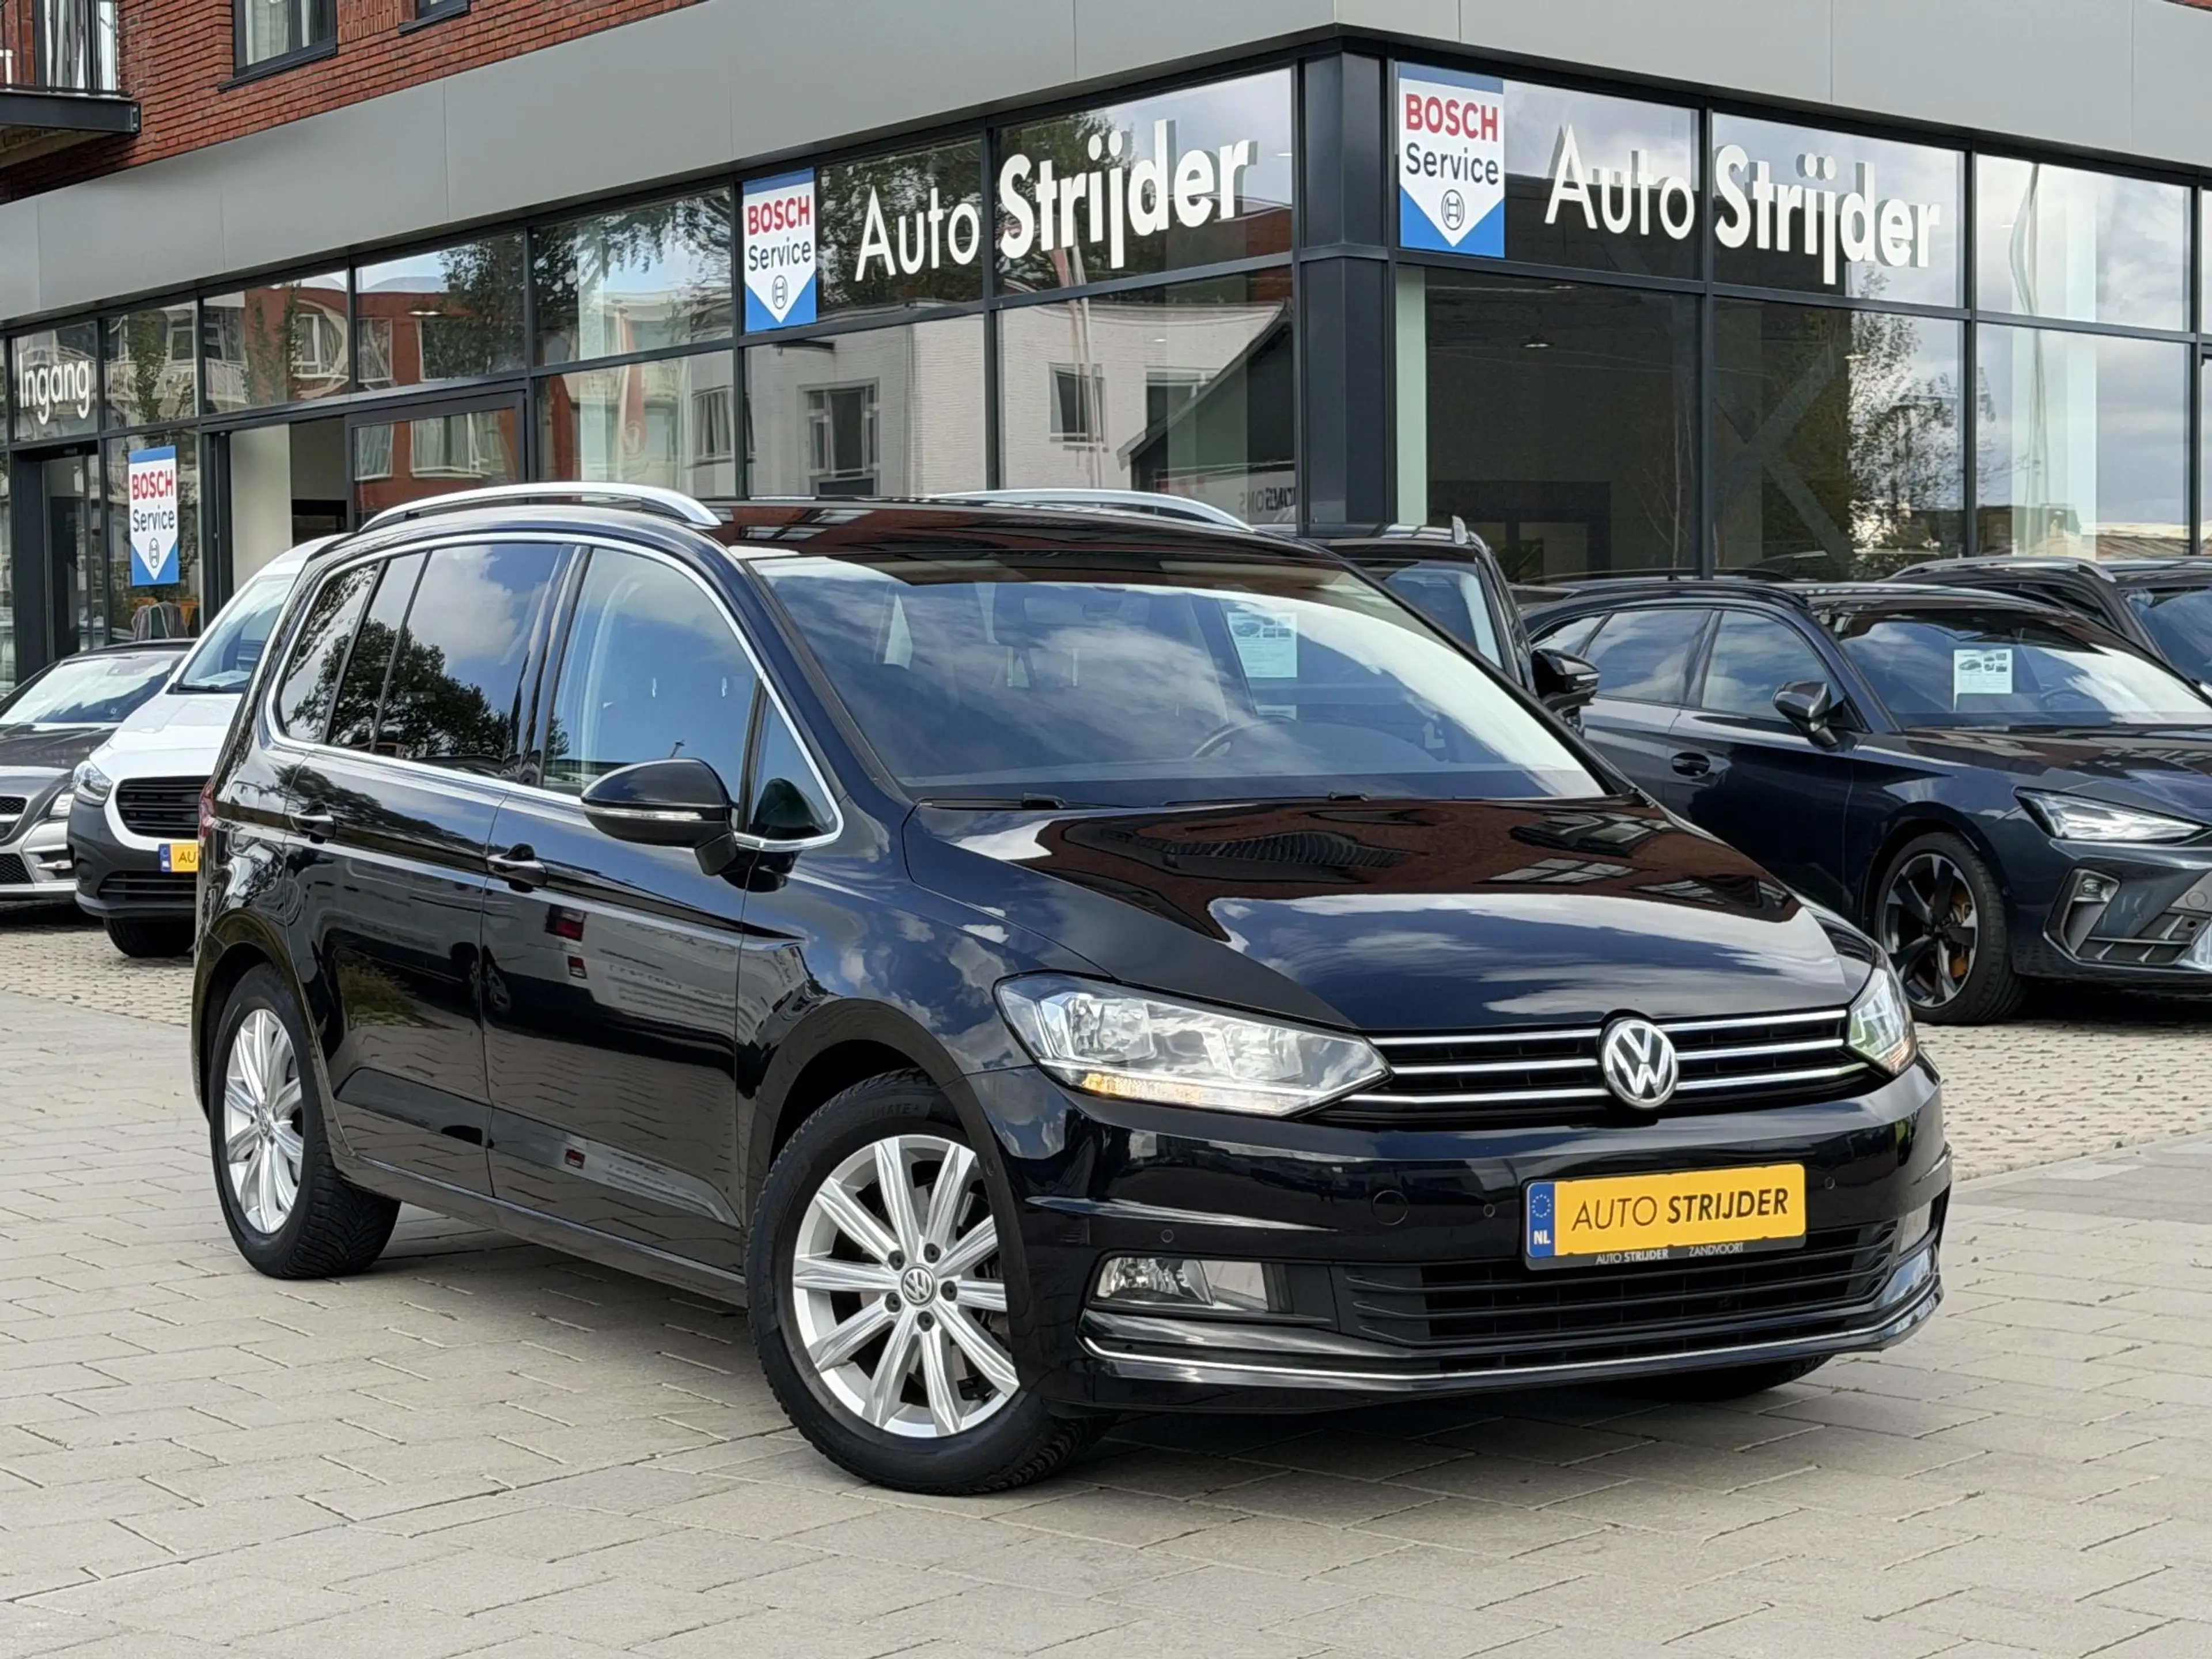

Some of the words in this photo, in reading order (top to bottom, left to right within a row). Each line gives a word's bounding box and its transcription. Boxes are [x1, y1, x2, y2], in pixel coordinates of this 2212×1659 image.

[1405, 93, 1498, 142] BOSCH
[1405, 142, 1499, 185] Service
[748, 195, 810, 236] BOSCH
[855, 184, 980, 282] Auto
[998, 119, 1253, 269] Strijder
[1544, 123, 1695, 240] Auto
[1714, 143, 1941, 285] Strijder
[748, 237, 812, 271] Service
[18, 354, 90, 425] Ingang
[132, 469, 174, 501] BOSCH
[132, 505, 175, 533] Service
[178, 850, 198, 863] AU
[1571, 1196, 1658, 1231] AUTO
[1666, 1188, 1789, 1224] STRIJDER
[1533, 1229, 1551, 1245] NL
[1595, 1252, 1622, 1265] AUTO
[1624, 1249, 1669, 1262] STRIJDER
[1688, 1242, 1744, 1257] ZANDVOORT
